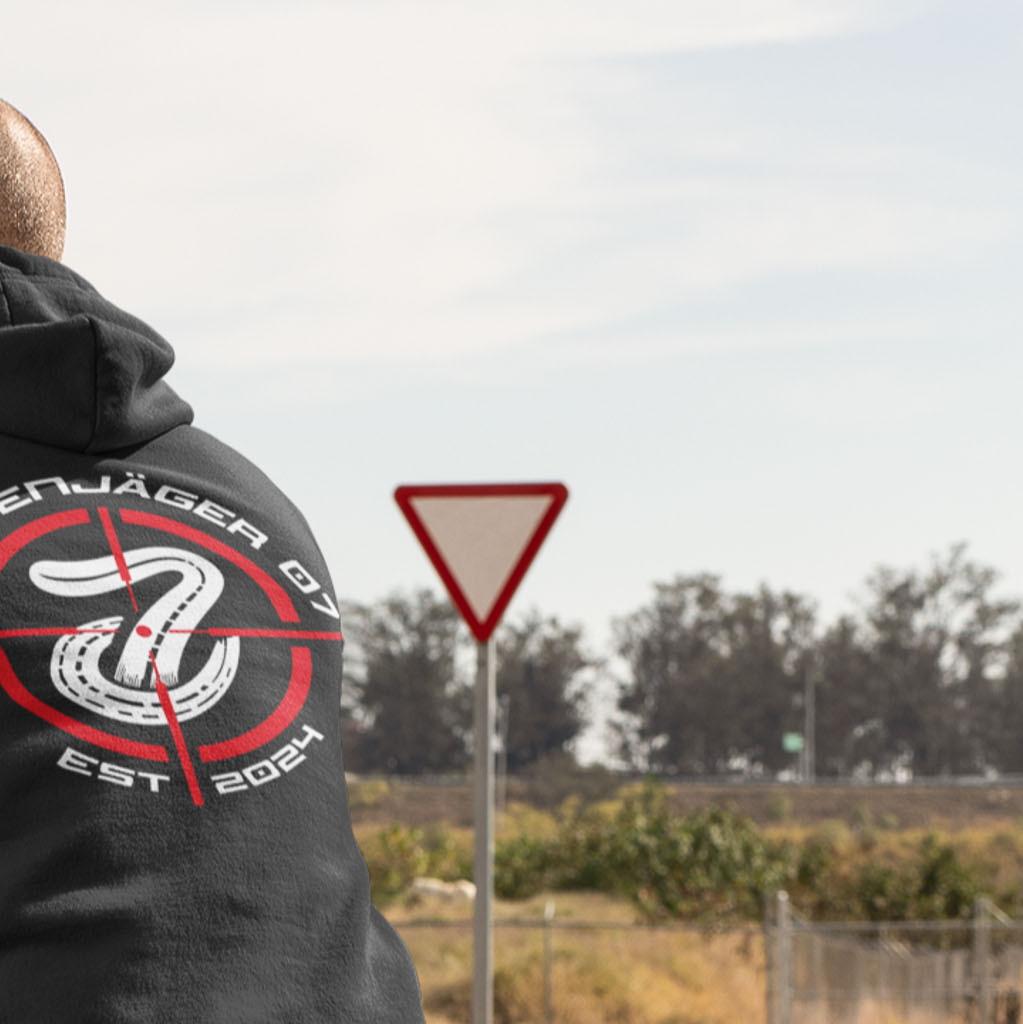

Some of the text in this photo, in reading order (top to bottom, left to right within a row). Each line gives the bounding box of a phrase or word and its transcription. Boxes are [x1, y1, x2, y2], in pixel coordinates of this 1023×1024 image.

[278, 559, 340, 619] 07
[57, 724, 324, 795] EST 2024
